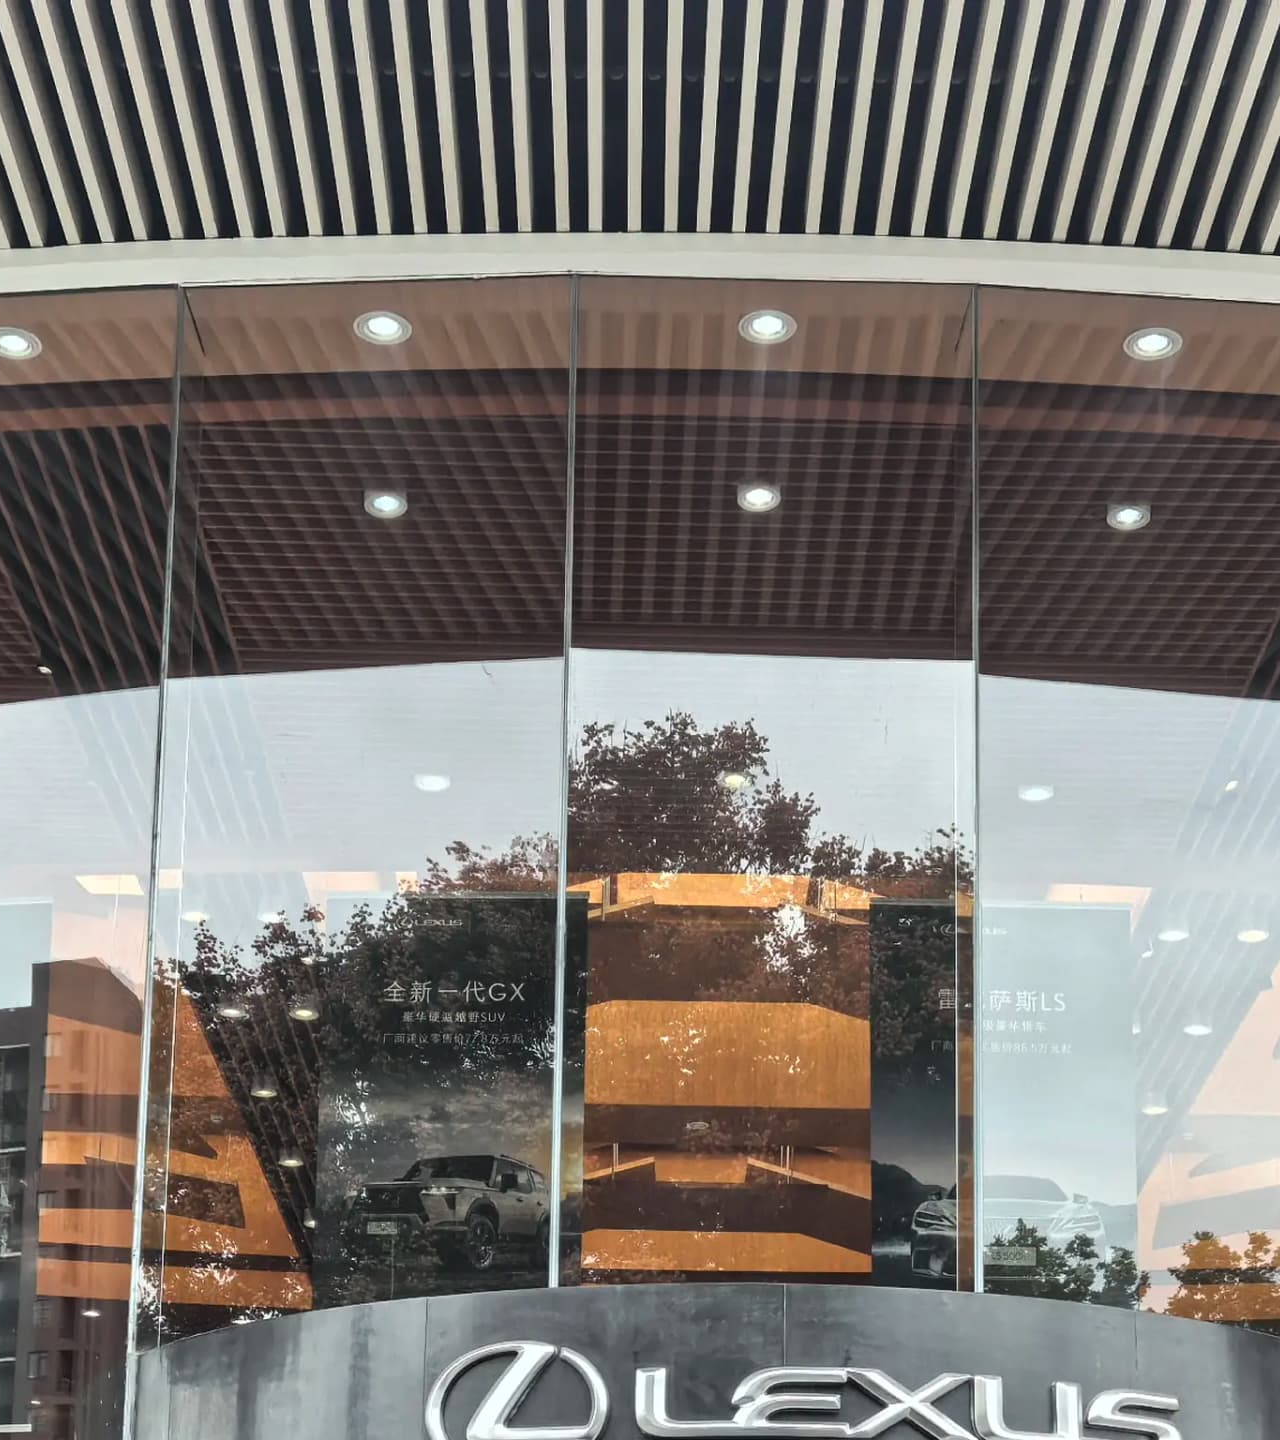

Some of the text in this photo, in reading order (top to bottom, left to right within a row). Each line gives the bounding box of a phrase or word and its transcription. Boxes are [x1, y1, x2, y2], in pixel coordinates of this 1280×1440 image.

[415, 919, 463, 927] LEXUS
[384, 980, 526, 1003] 全新一代GX
[938, 988, 1066, 1013] 雷萨斯LS
